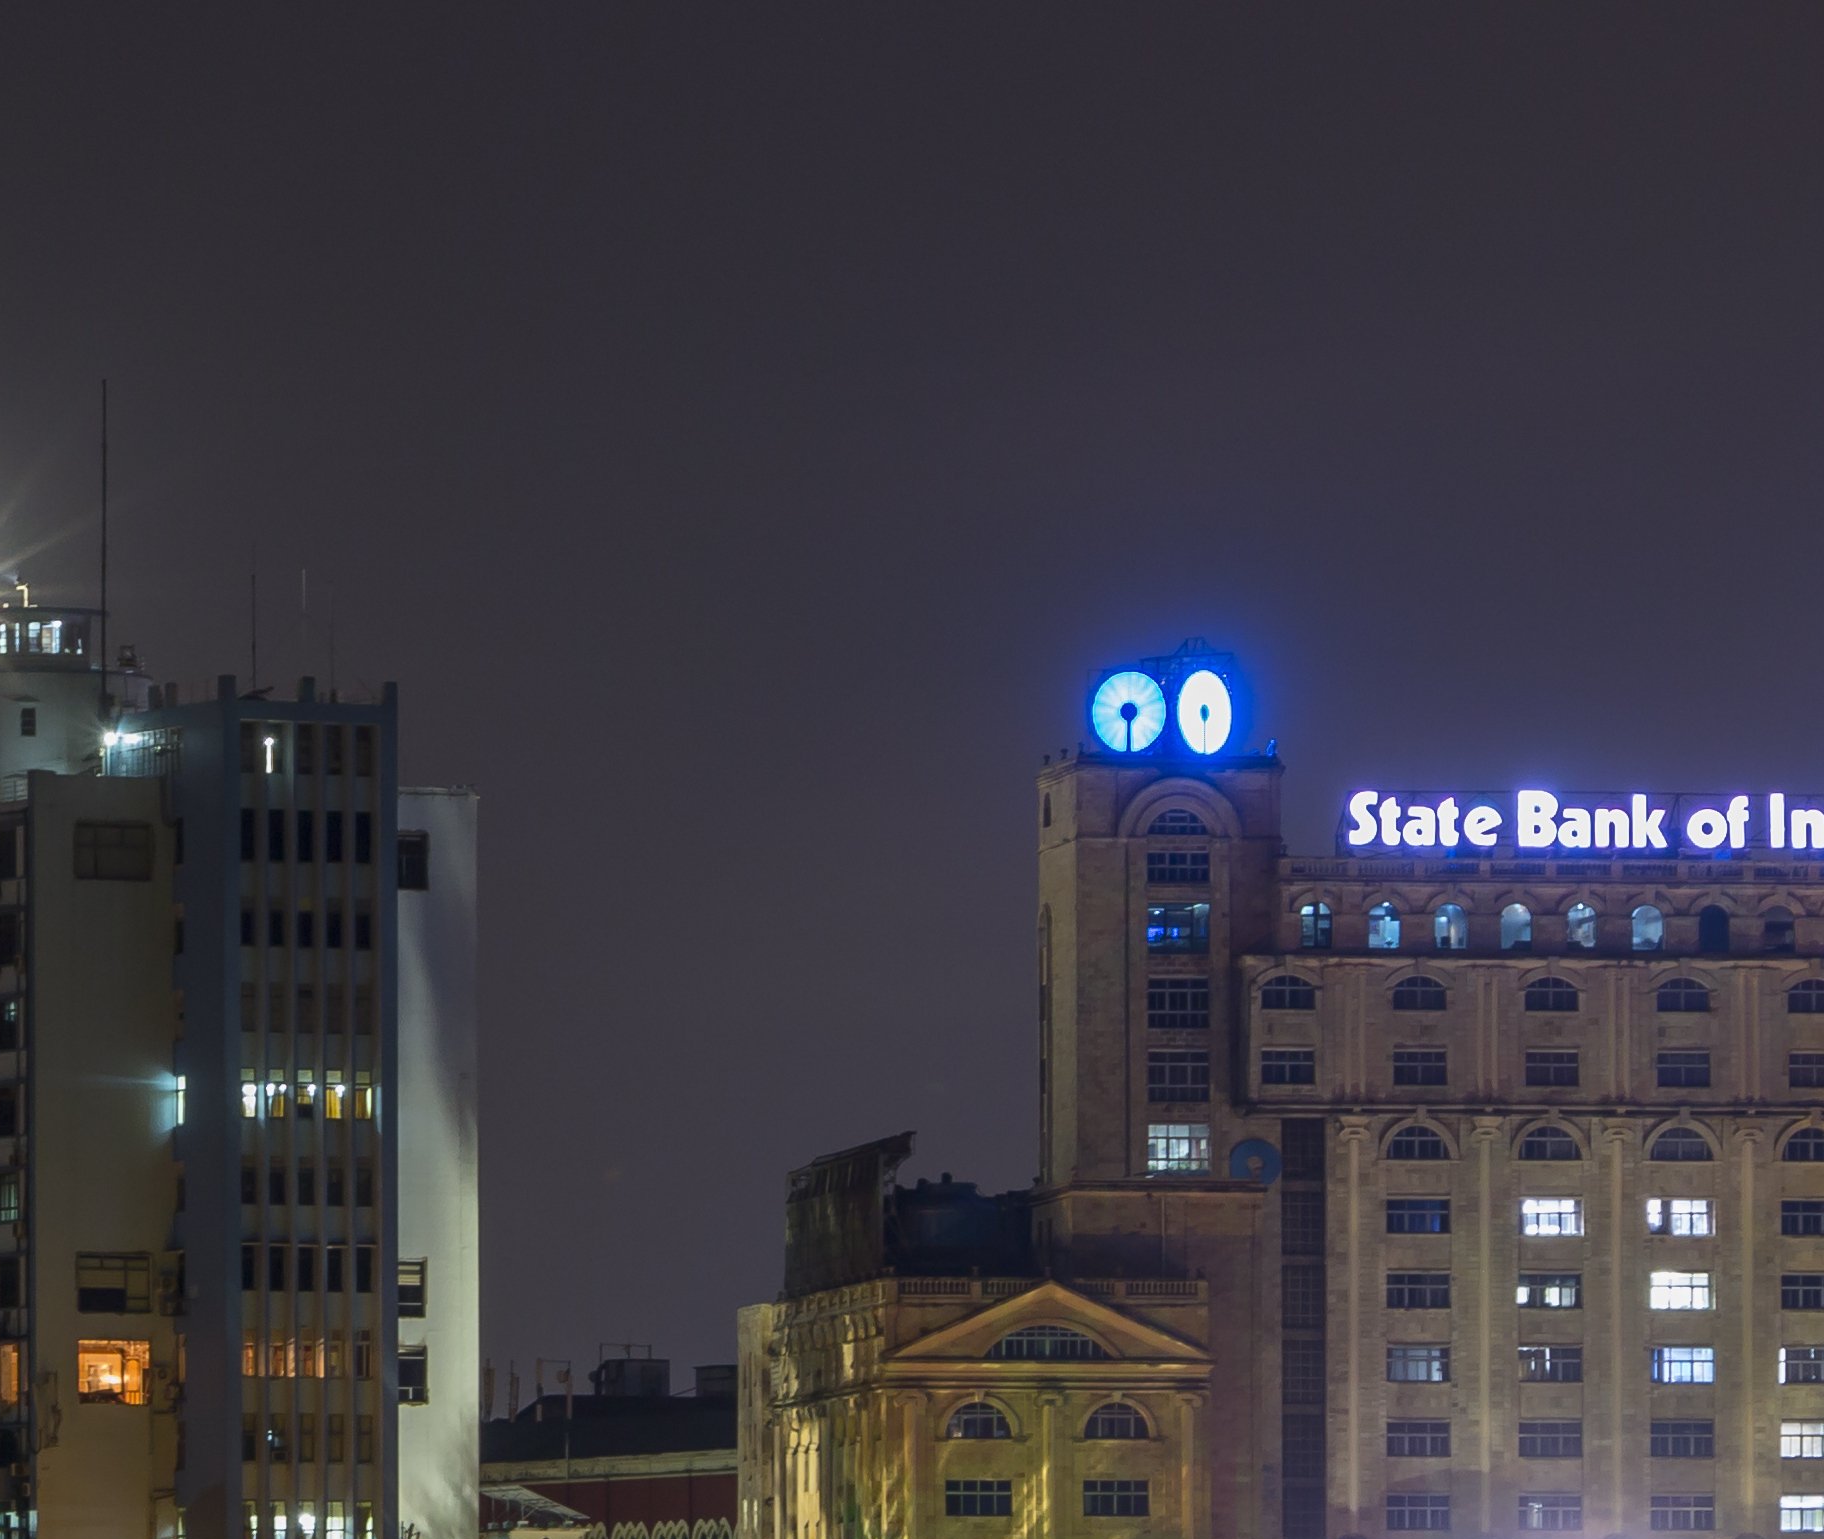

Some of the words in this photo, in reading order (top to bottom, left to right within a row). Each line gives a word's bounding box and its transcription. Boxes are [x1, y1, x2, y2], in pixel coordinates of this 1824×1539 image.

[1347, 790, 1503, 848] State
[1517, 789, 1668, 850] Bank
[1686, 795, 1750, 850] of
